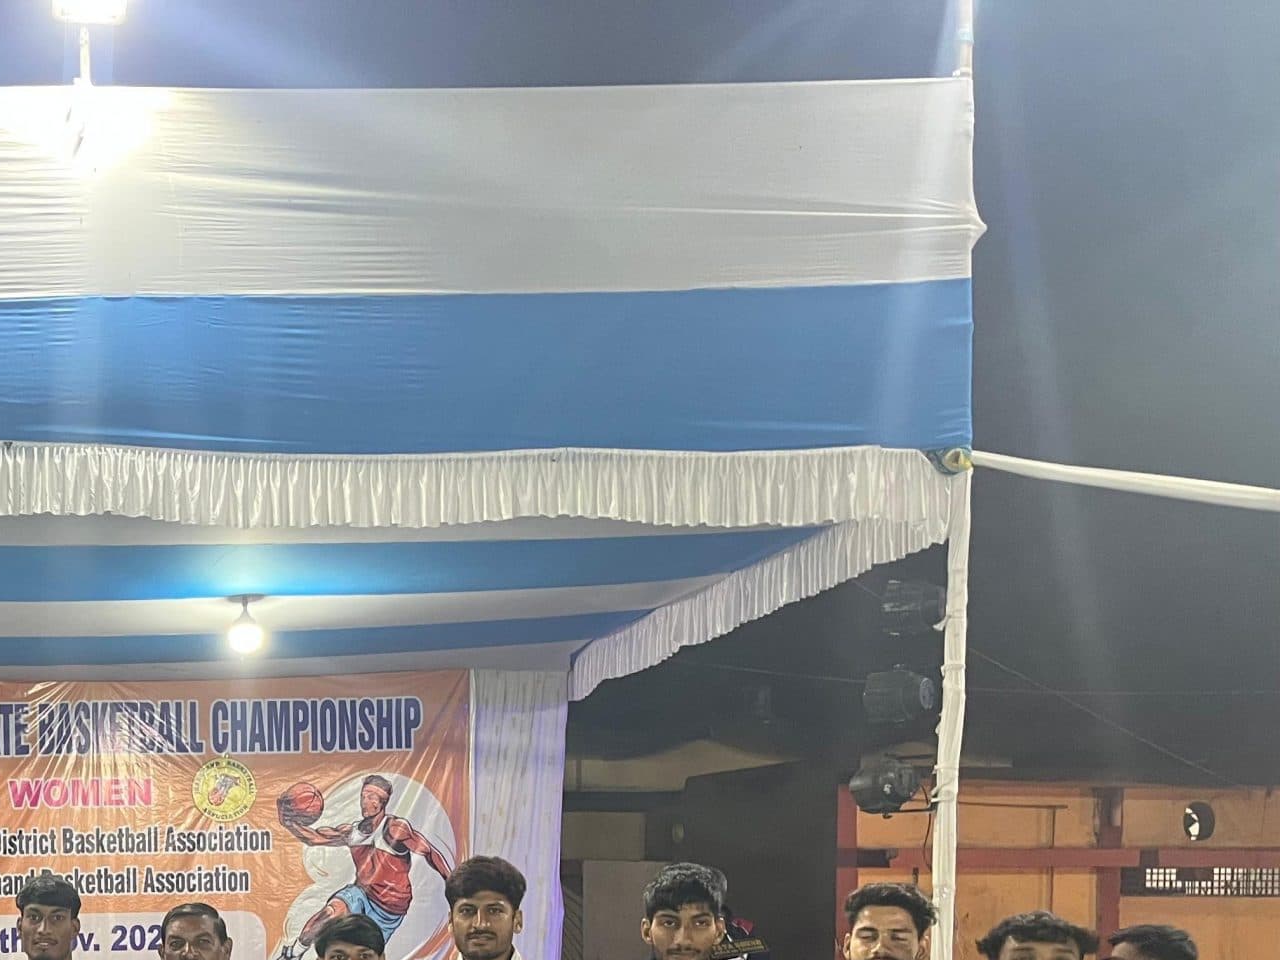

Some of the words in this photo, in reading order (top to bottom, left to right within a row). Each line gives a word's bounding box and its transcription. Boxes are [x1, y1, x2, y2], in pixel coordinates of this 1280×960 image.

[38, 700, 204, 755] BASKETBALL
[210, 696, 422, 754] CHAMPIONSHIP
[8, 777, 153, 808] WOMEN
[62, 826, 158, 855] Basketball
[164, 824, 272, 853] Association
[143, 865, 250, 894] Association
